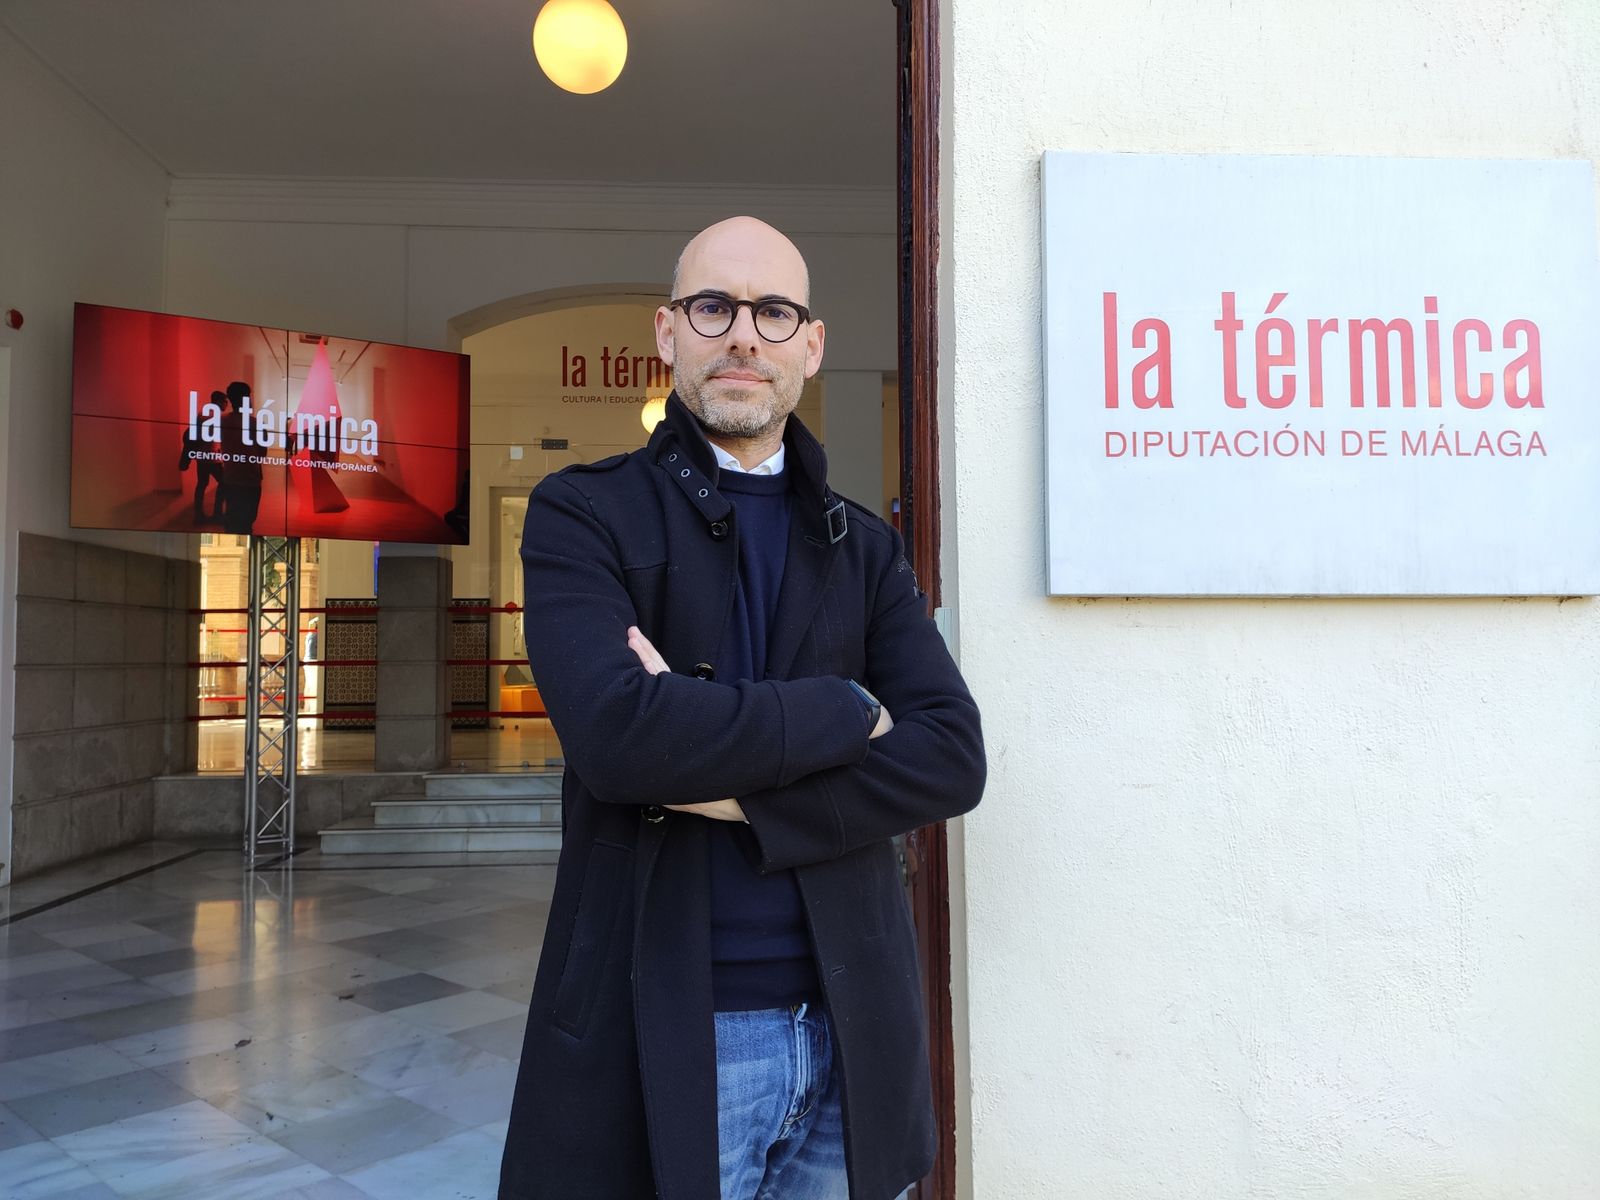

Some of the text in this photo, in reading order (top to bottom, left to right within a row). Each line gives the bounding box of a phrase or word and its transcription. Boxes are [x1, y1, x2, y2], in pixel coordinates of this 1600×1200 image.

[561, 346, 587, 388] la
[1102, 291, 1545, 410] la térmica
[561, 395, 602, 404] CULTURA
[188, 390, 379, 456] la térmica
[1104, 423, 1548, 458] DIPUTACIÓN DE MÁLAGA
[188, 450, 379, 474] CENTRO DE CULTURA CONTEMPORÁNEA
